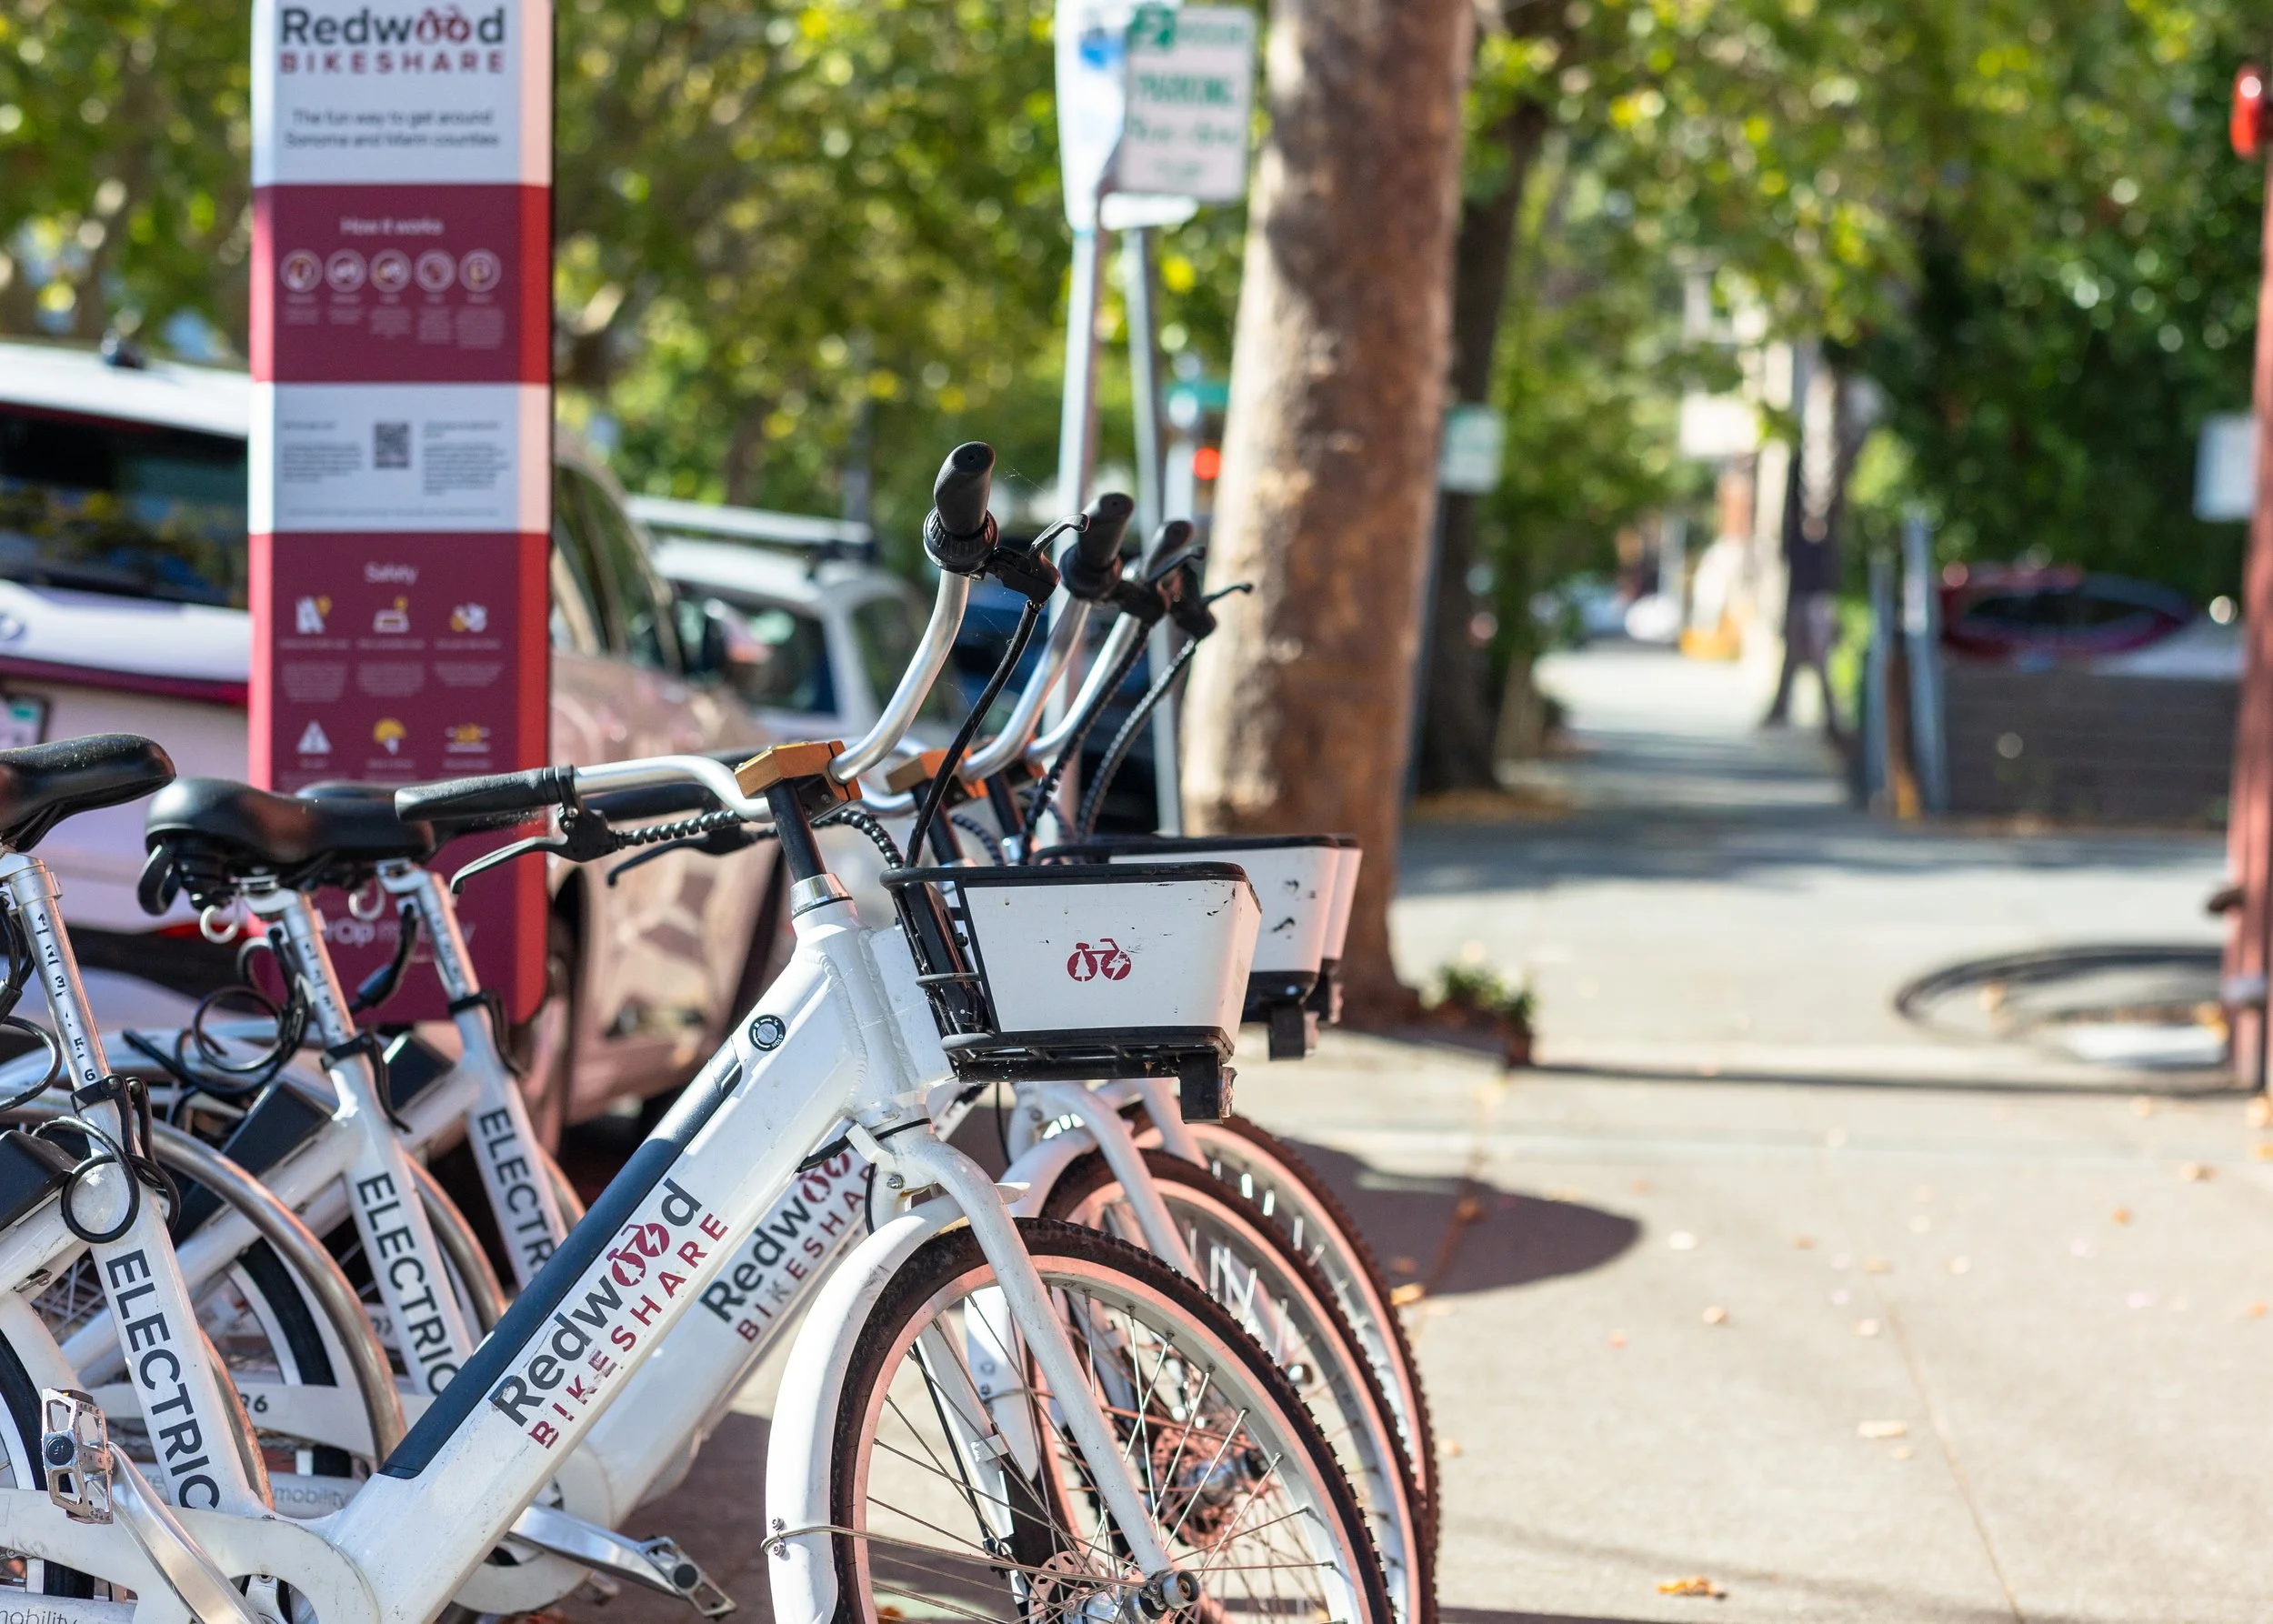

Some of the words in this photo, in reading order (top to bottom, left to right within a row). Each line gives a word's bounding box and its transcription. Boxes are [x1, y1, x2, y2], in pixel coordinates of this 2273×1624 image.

[281, 6, 505, 45] Redwood
[279, 50, 503, 75] BIKESHARE
[293, 108, 320, 125] The
[326, 107, 349, 125] fun
[355, 112, 385, 129] way
[388, 109, 404, 125] to
[411, 110, 434, 130] get
[439, 108, 494, 125] around
[285, 130, 348, 150] Sonoma
[355, 131, 380, 149] and
[434, 131, 500, 150] counties
[339, 216, 378, 236] How
[395, 216, 445, 236] works
[365, 561, 419, 586] Safety
[771, 1034, 784, 1048] HOLD
[84, 1068, 96, 1082] 6
[478, 1107, 556, 1270] ELECTR
[488, 1178, 703, 1427] Redwood
[527, 1213, 729, 1449] BIKESHARE
[105, 1248, 220, 1509] ELECTRIC
